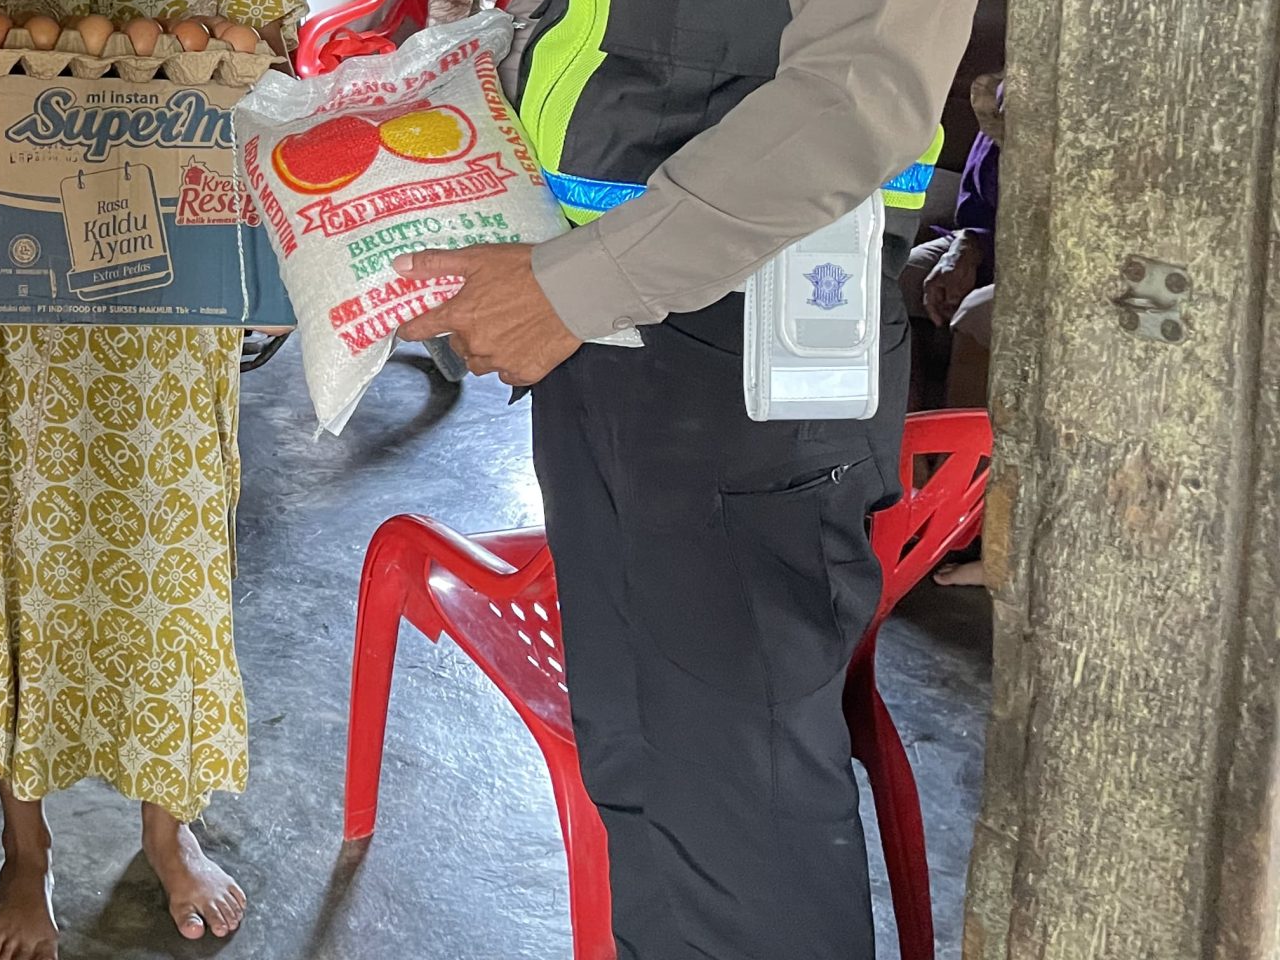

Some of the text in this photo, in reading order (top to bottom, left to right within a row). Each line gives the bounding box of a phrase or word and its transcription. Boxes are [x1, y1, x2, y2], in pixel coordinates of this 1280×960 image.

[86, 90, 159, 104] mi instan
[6, 87, 234, 162] SuperM
[499, 125, 547, 187] BERAS
[97, 198, 129, 215] Rasa
[259, 183, 298, 260] MEDIUM
[327, 200, 367, 230] CAP
[83, 211, 147, 243] Kaldu
[347, 216, 442, 259] BRUTTO
[459, 213, 474, 230] 5
[475, 211, 509, 230] kg
[89, 233, 154, 264] Ayam
[93, 262, 151, 283] Extra Pedas
[37, 304, 47, 313] PT
[48, 304, 91, 313] INDFOOD
[94, 333, 122, 368] CHANEL
[49, 372, 80, 407] CHANEL
[93, 447, 124, 486] CHANEL
[51, 491, 81, 522] CHANEL
[165, 508, 193, 541] CHANEL
[98, 557, 128, 580] CHANEL
[175, 614, 208, 645] CHANEL
[151, 720, 181, 749] CHANEL
